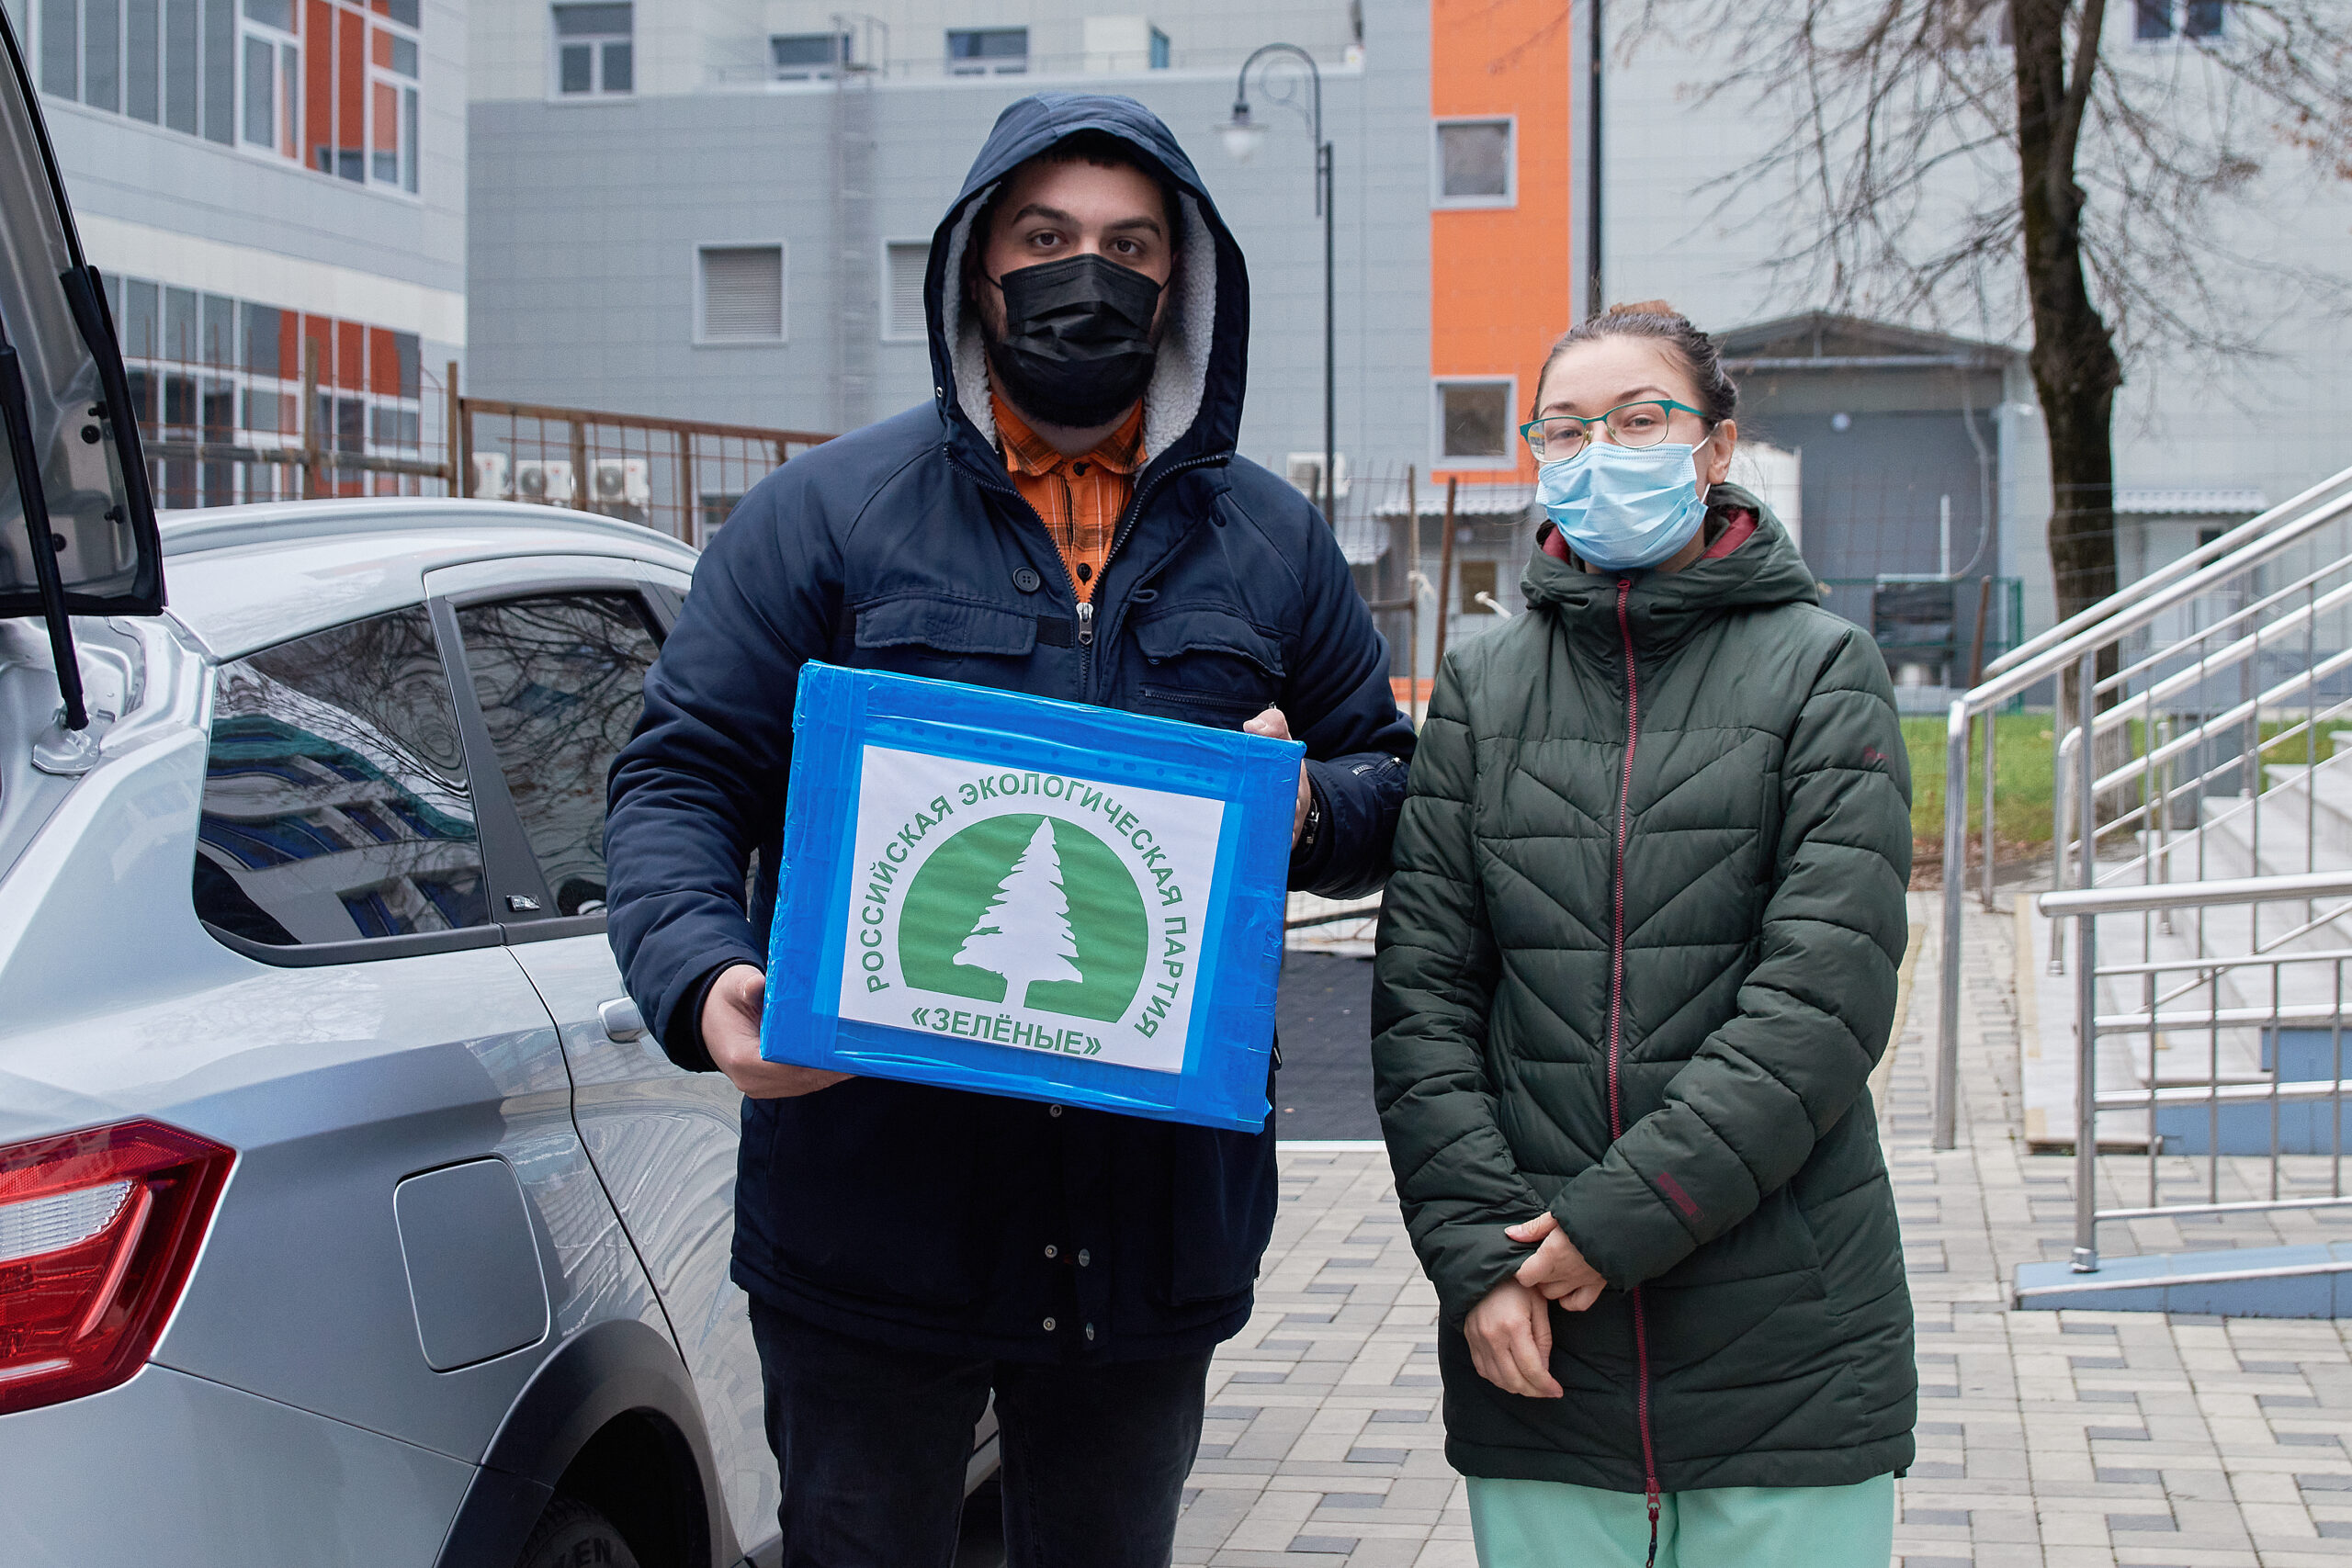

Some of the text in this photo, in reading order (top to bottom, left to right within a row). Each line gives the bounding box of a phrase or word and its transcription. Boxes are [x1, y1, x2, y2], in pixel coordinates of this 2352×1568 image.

[860, 772, 1187, 1039] РОССИЙСКАЯ ЭКОЛОГИЧЕСКАЯ ПАРТИЯ
[910, 1006, 1102, 1055] «ЗЕЛЁНЫЕ»
